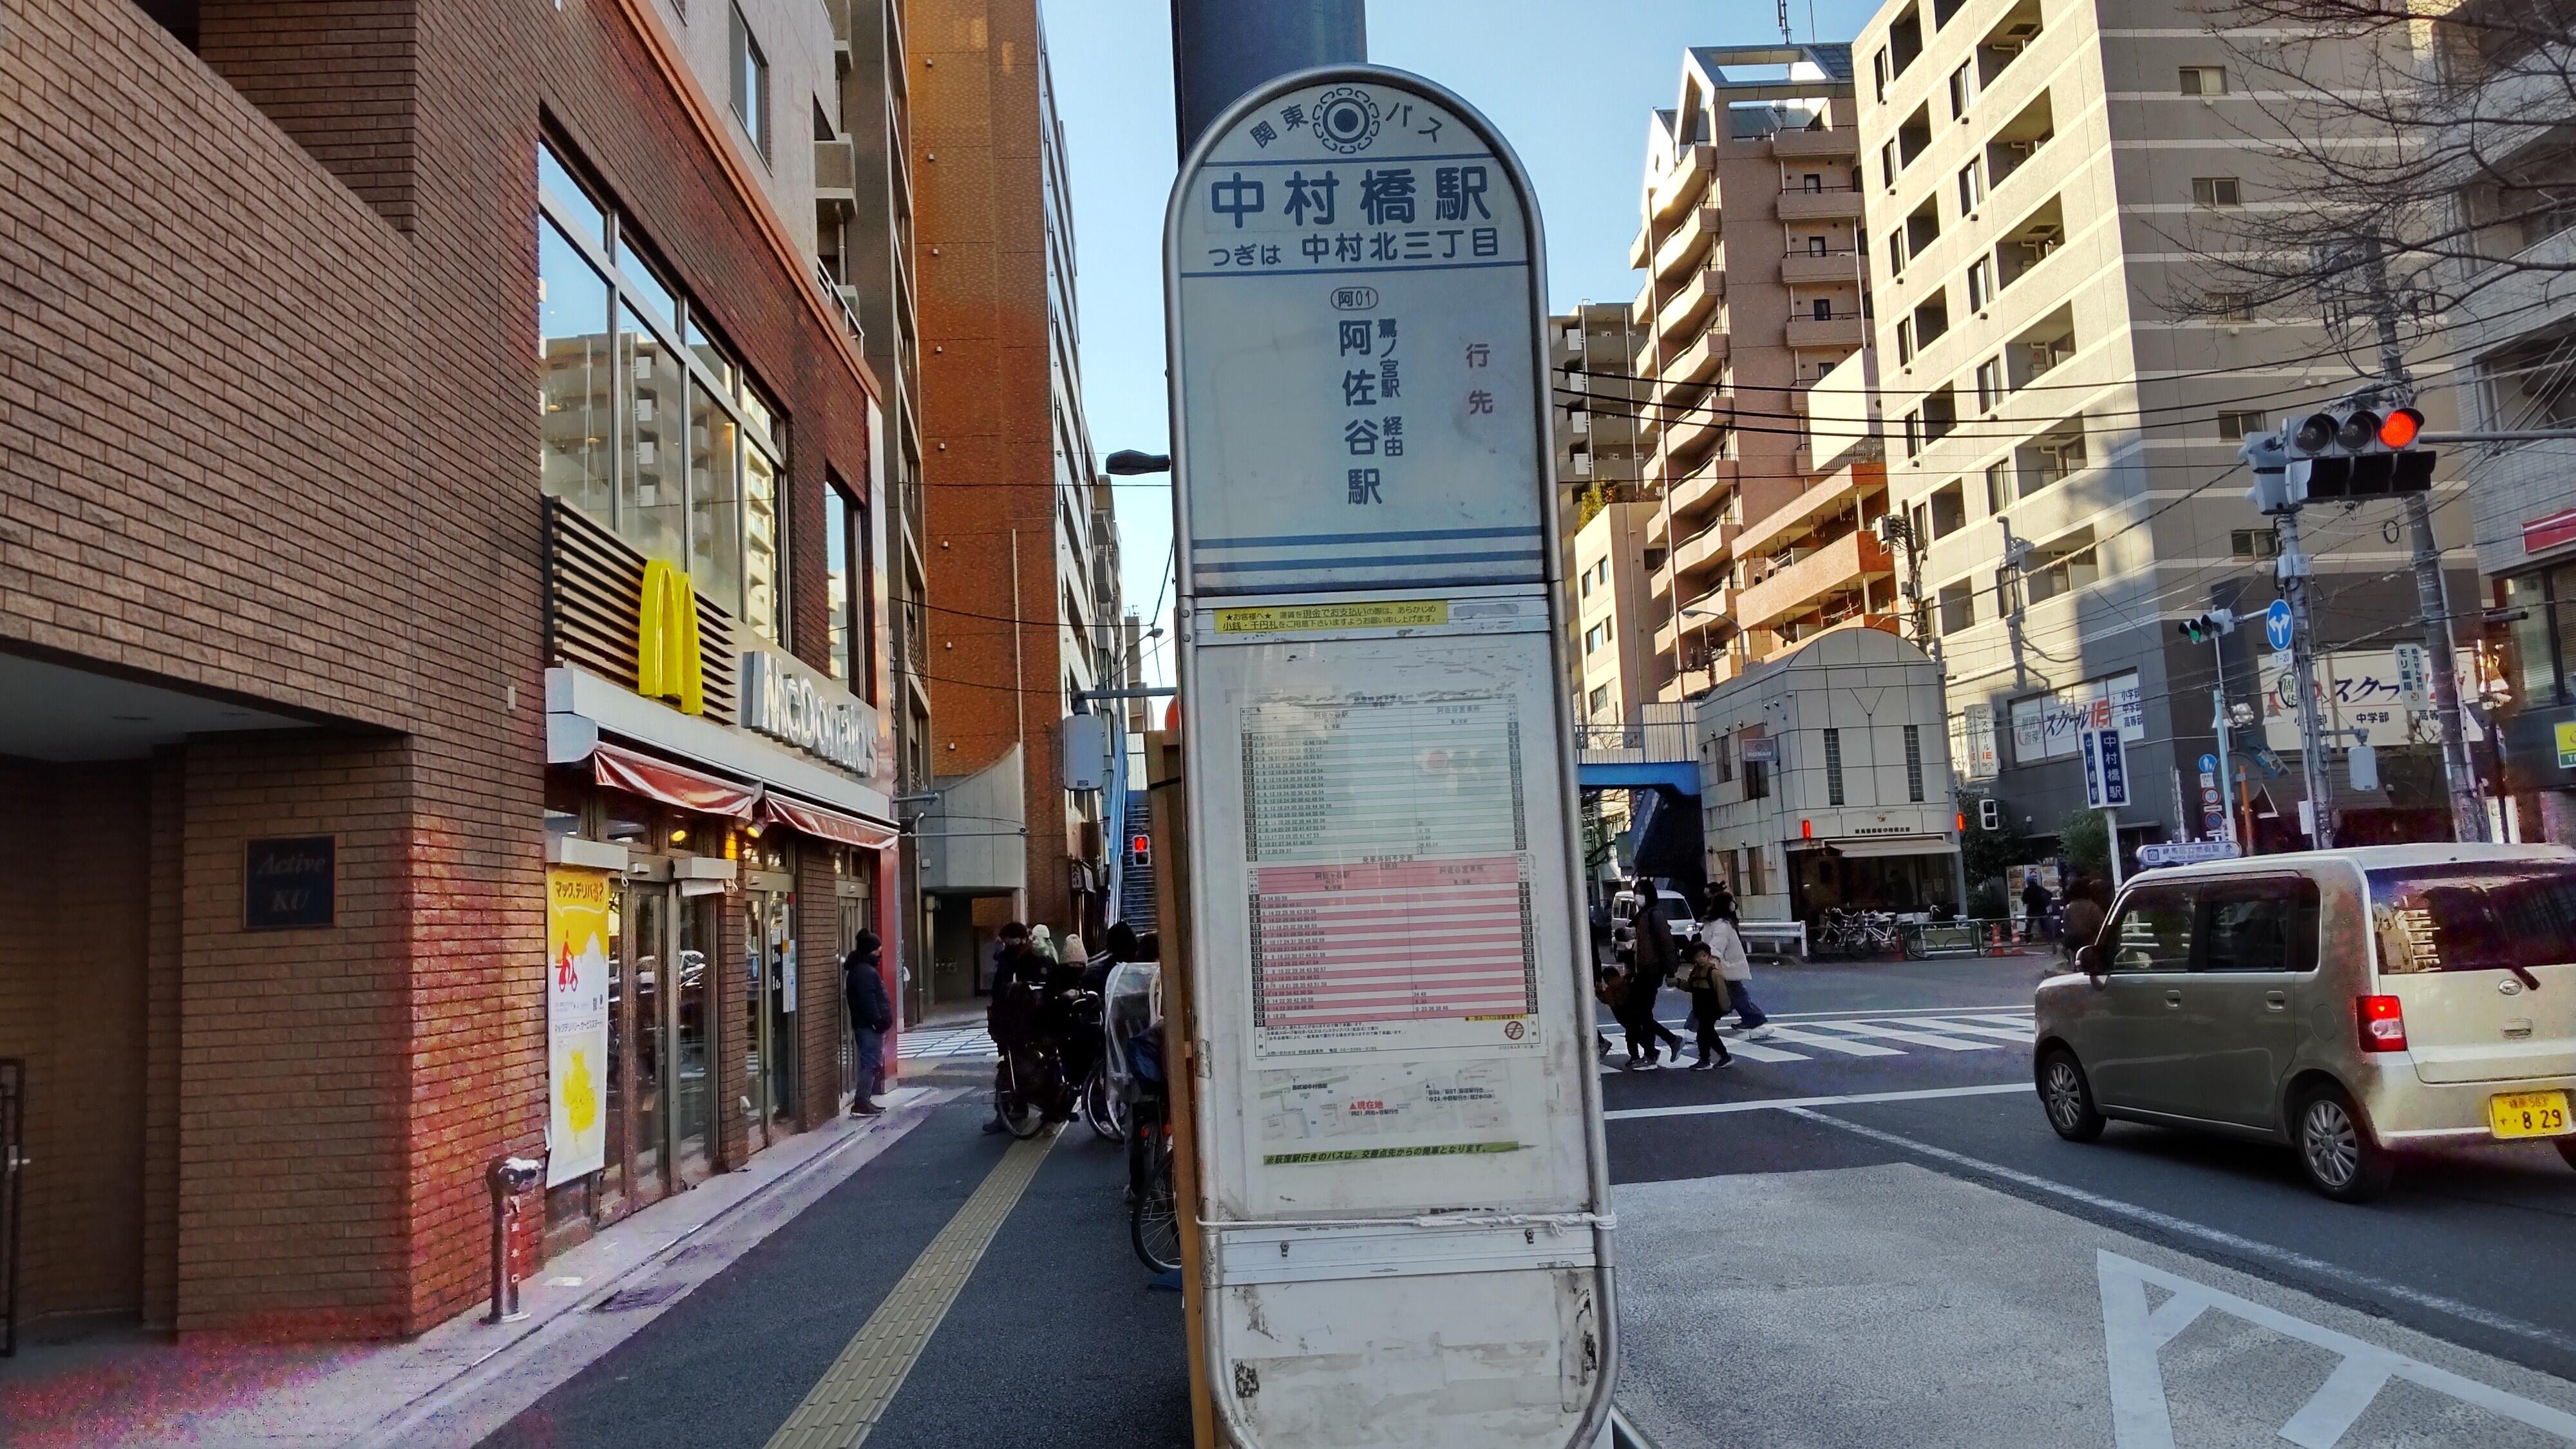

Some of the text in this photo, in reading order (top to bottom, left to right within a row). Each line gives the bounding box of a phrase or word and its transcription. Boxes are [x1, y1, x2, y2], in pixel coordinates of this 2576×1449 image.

[1249, 101, 1442, 148] 関東 バス
[1211, 166, 1492, 229] 中村橋駅
[1208, 227, 1498, 267] つぎは 中村北三丁目
[1338, 290, 1371, 307] 阿01
[1466, 343, 1493, 415] 行先
[1340, 319, 1383, 506] 阿佐谷駅
[1382, 416, 1403, 457] 経由
[2274, 653, 2290, 663] 7-20
[2399, 649, 2412, 691] モリ薬局
[2356, 712, 2389, 723] 中学部
[2086, 737, 2098, 800] 中村橋駅
[2103, 735, 2123, 799] 中村橋駅
[1358, 1101, 1384, 1110] 現在地
